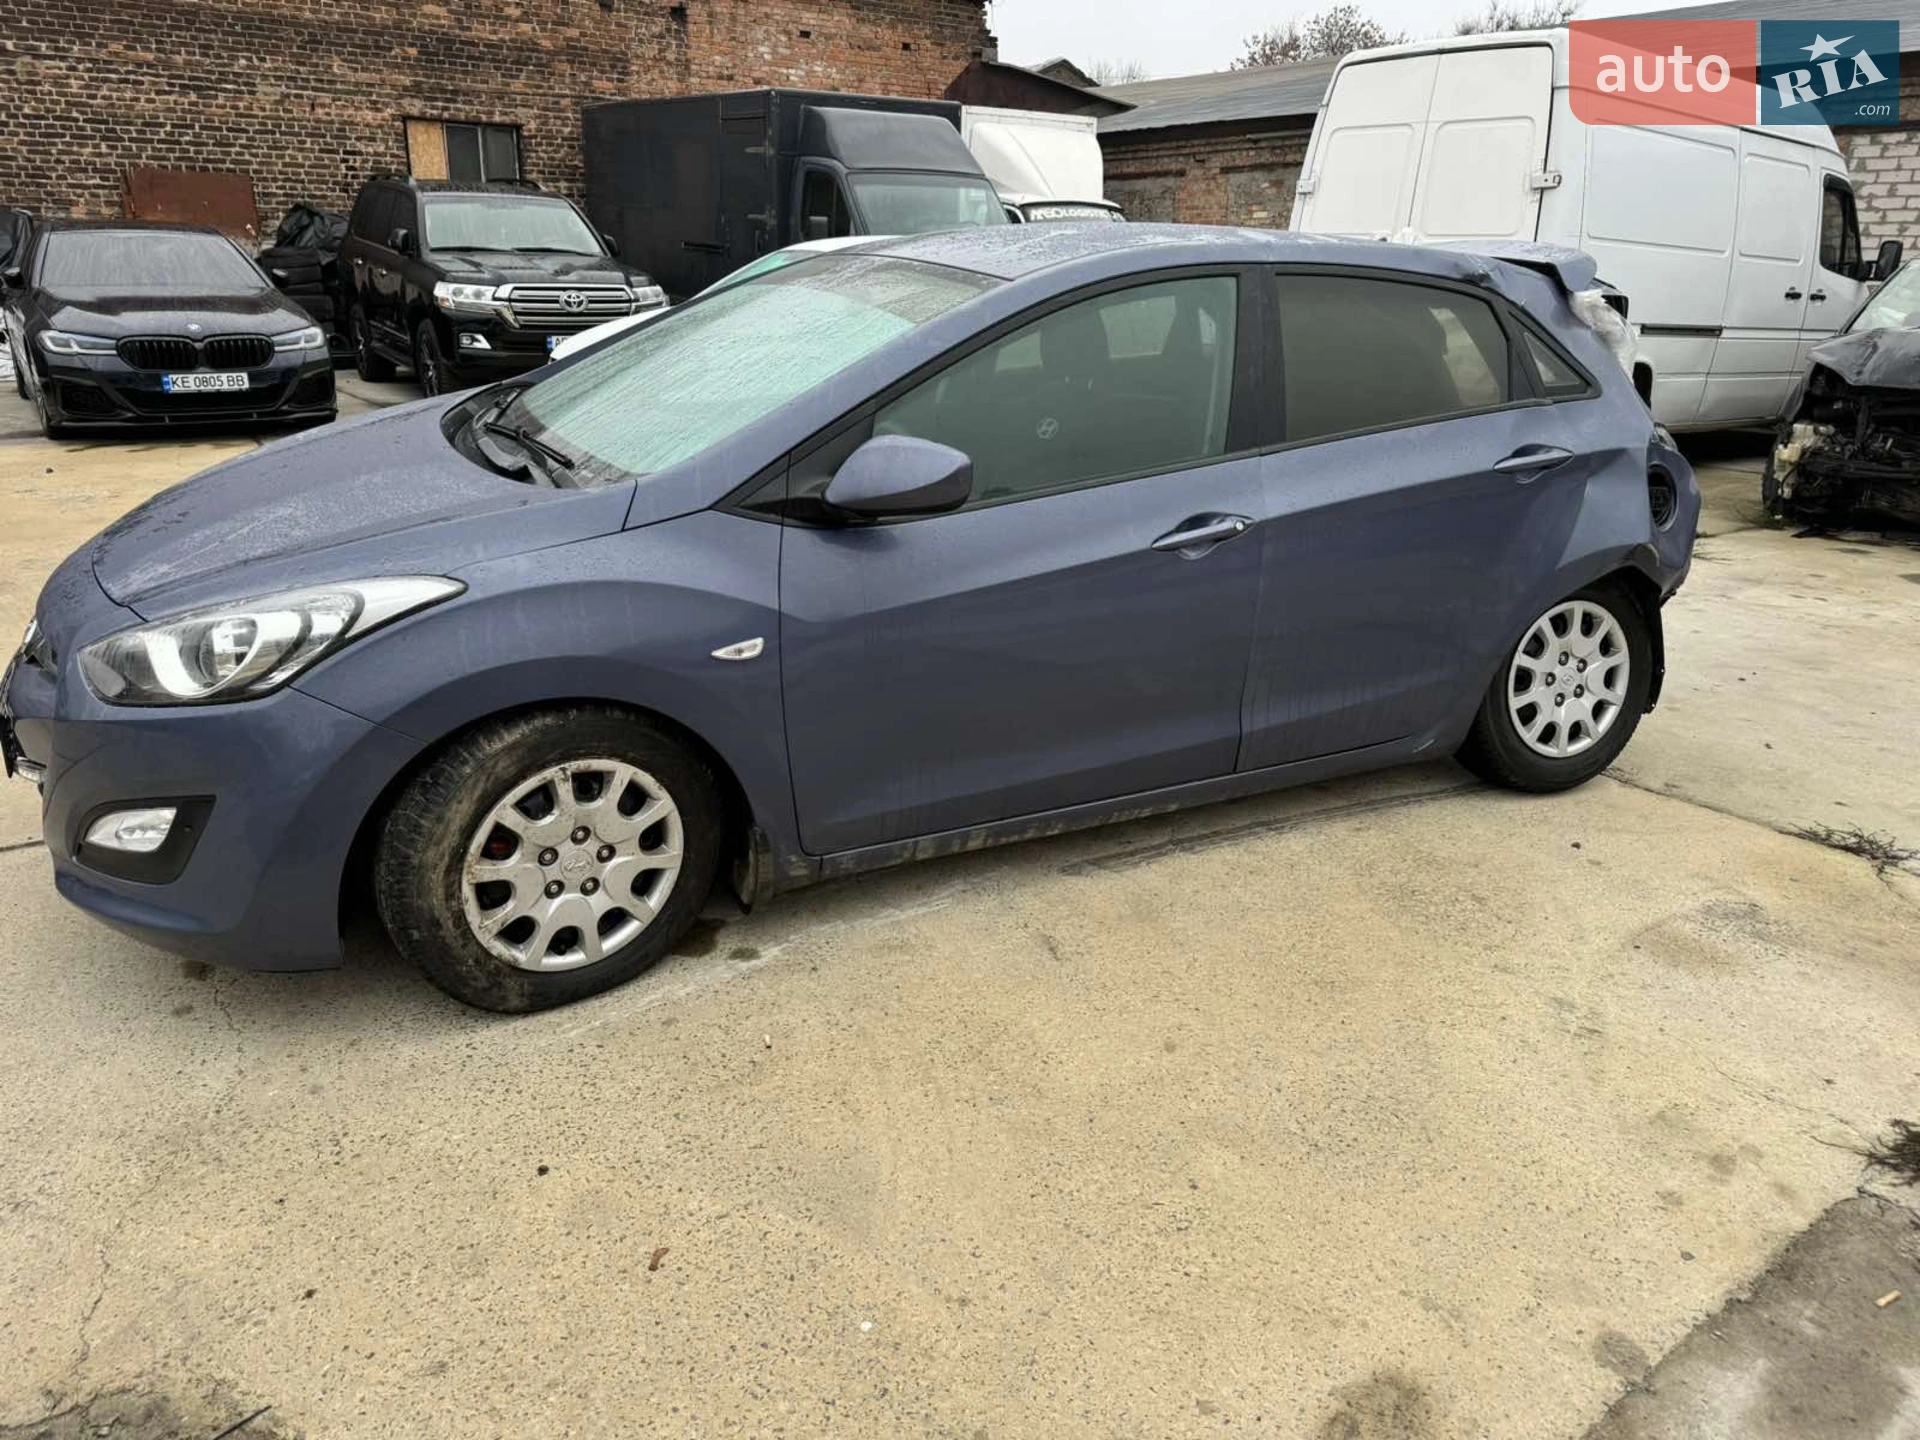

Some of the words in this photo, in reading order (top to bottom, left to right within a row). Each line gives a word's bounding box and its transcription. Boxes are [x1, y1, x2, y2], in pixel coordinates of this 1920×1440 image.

[171, 376, 191, 388] KE
[193, 375, 224, 388] 0805
[226, 374, 245, 387] BB
